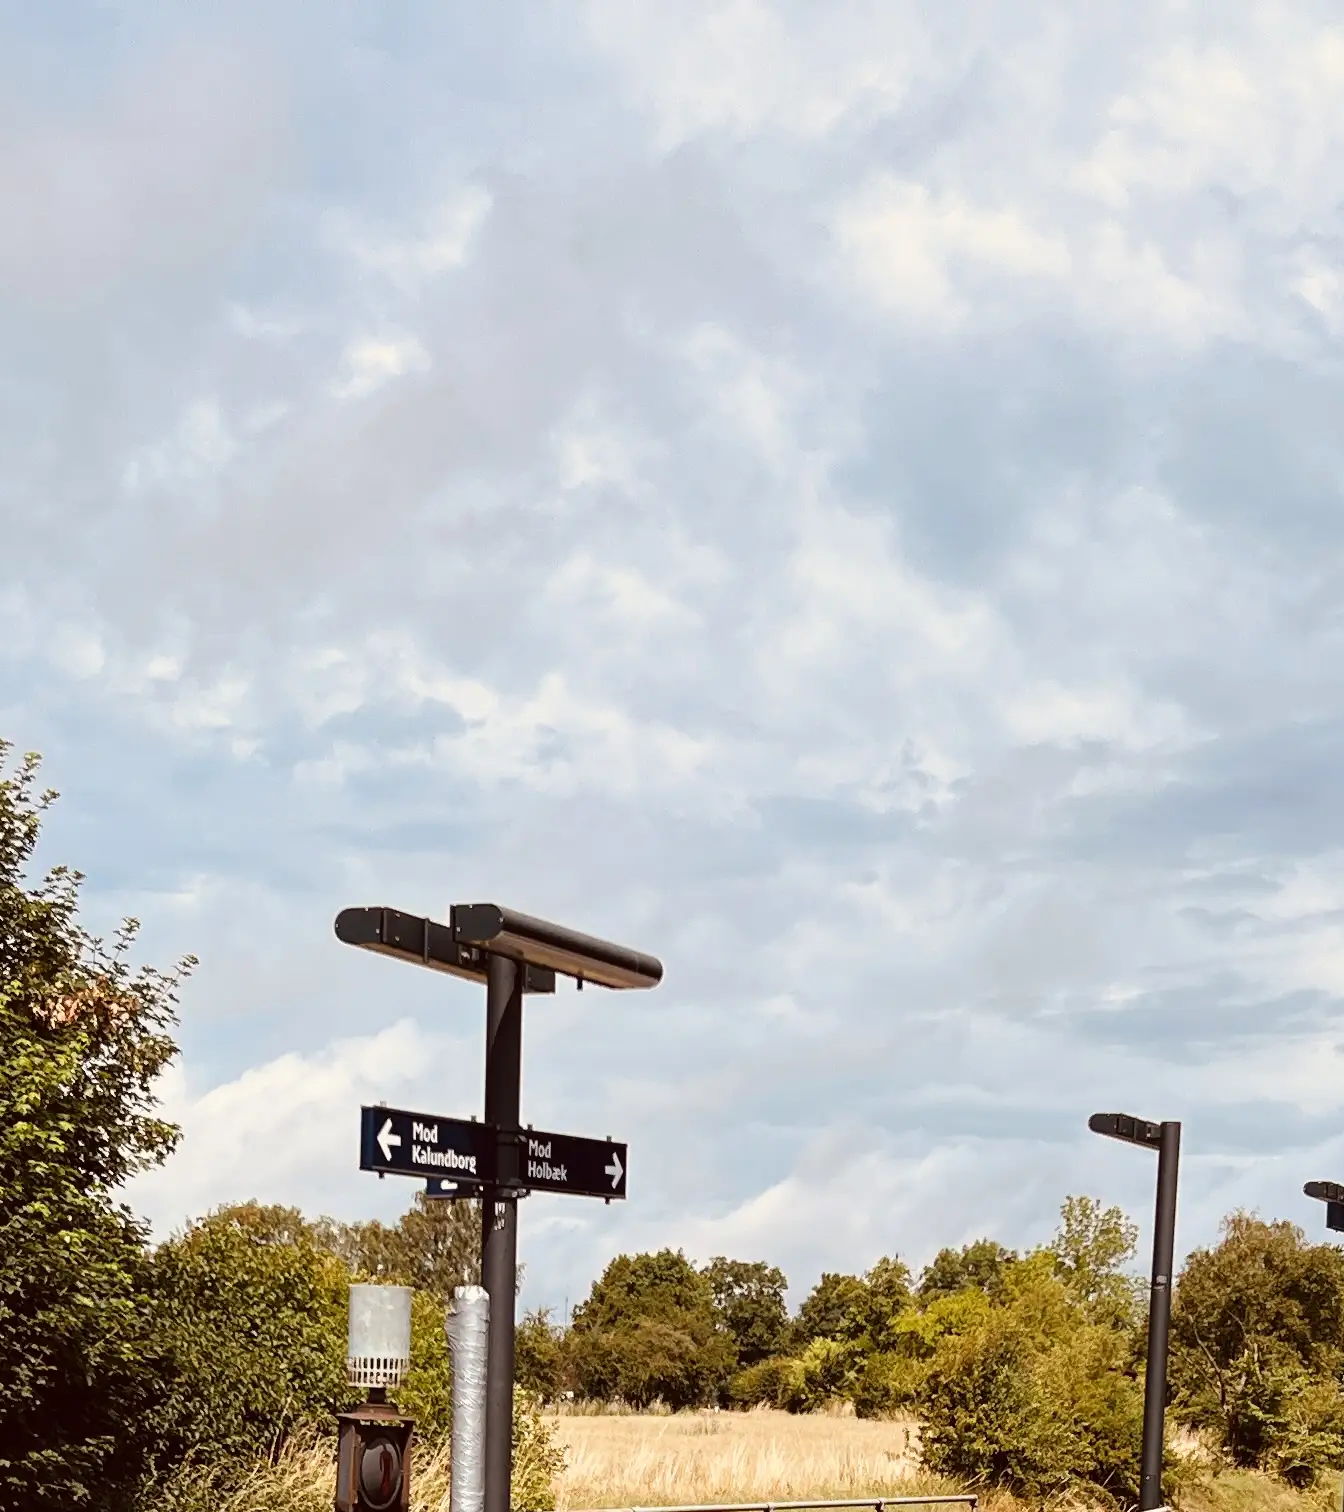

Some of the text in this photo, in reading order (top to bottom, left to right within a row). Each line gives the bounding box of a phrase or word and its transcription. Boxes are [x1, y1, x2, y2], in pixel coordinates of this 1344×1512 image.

[412, 1121, 438, 1144] Mod
[411, 1144, 477, 1175] Kalundborg
[528, 1138, 552, 1159] Mod
[527, 1159, 568, 1182] Holbæk
